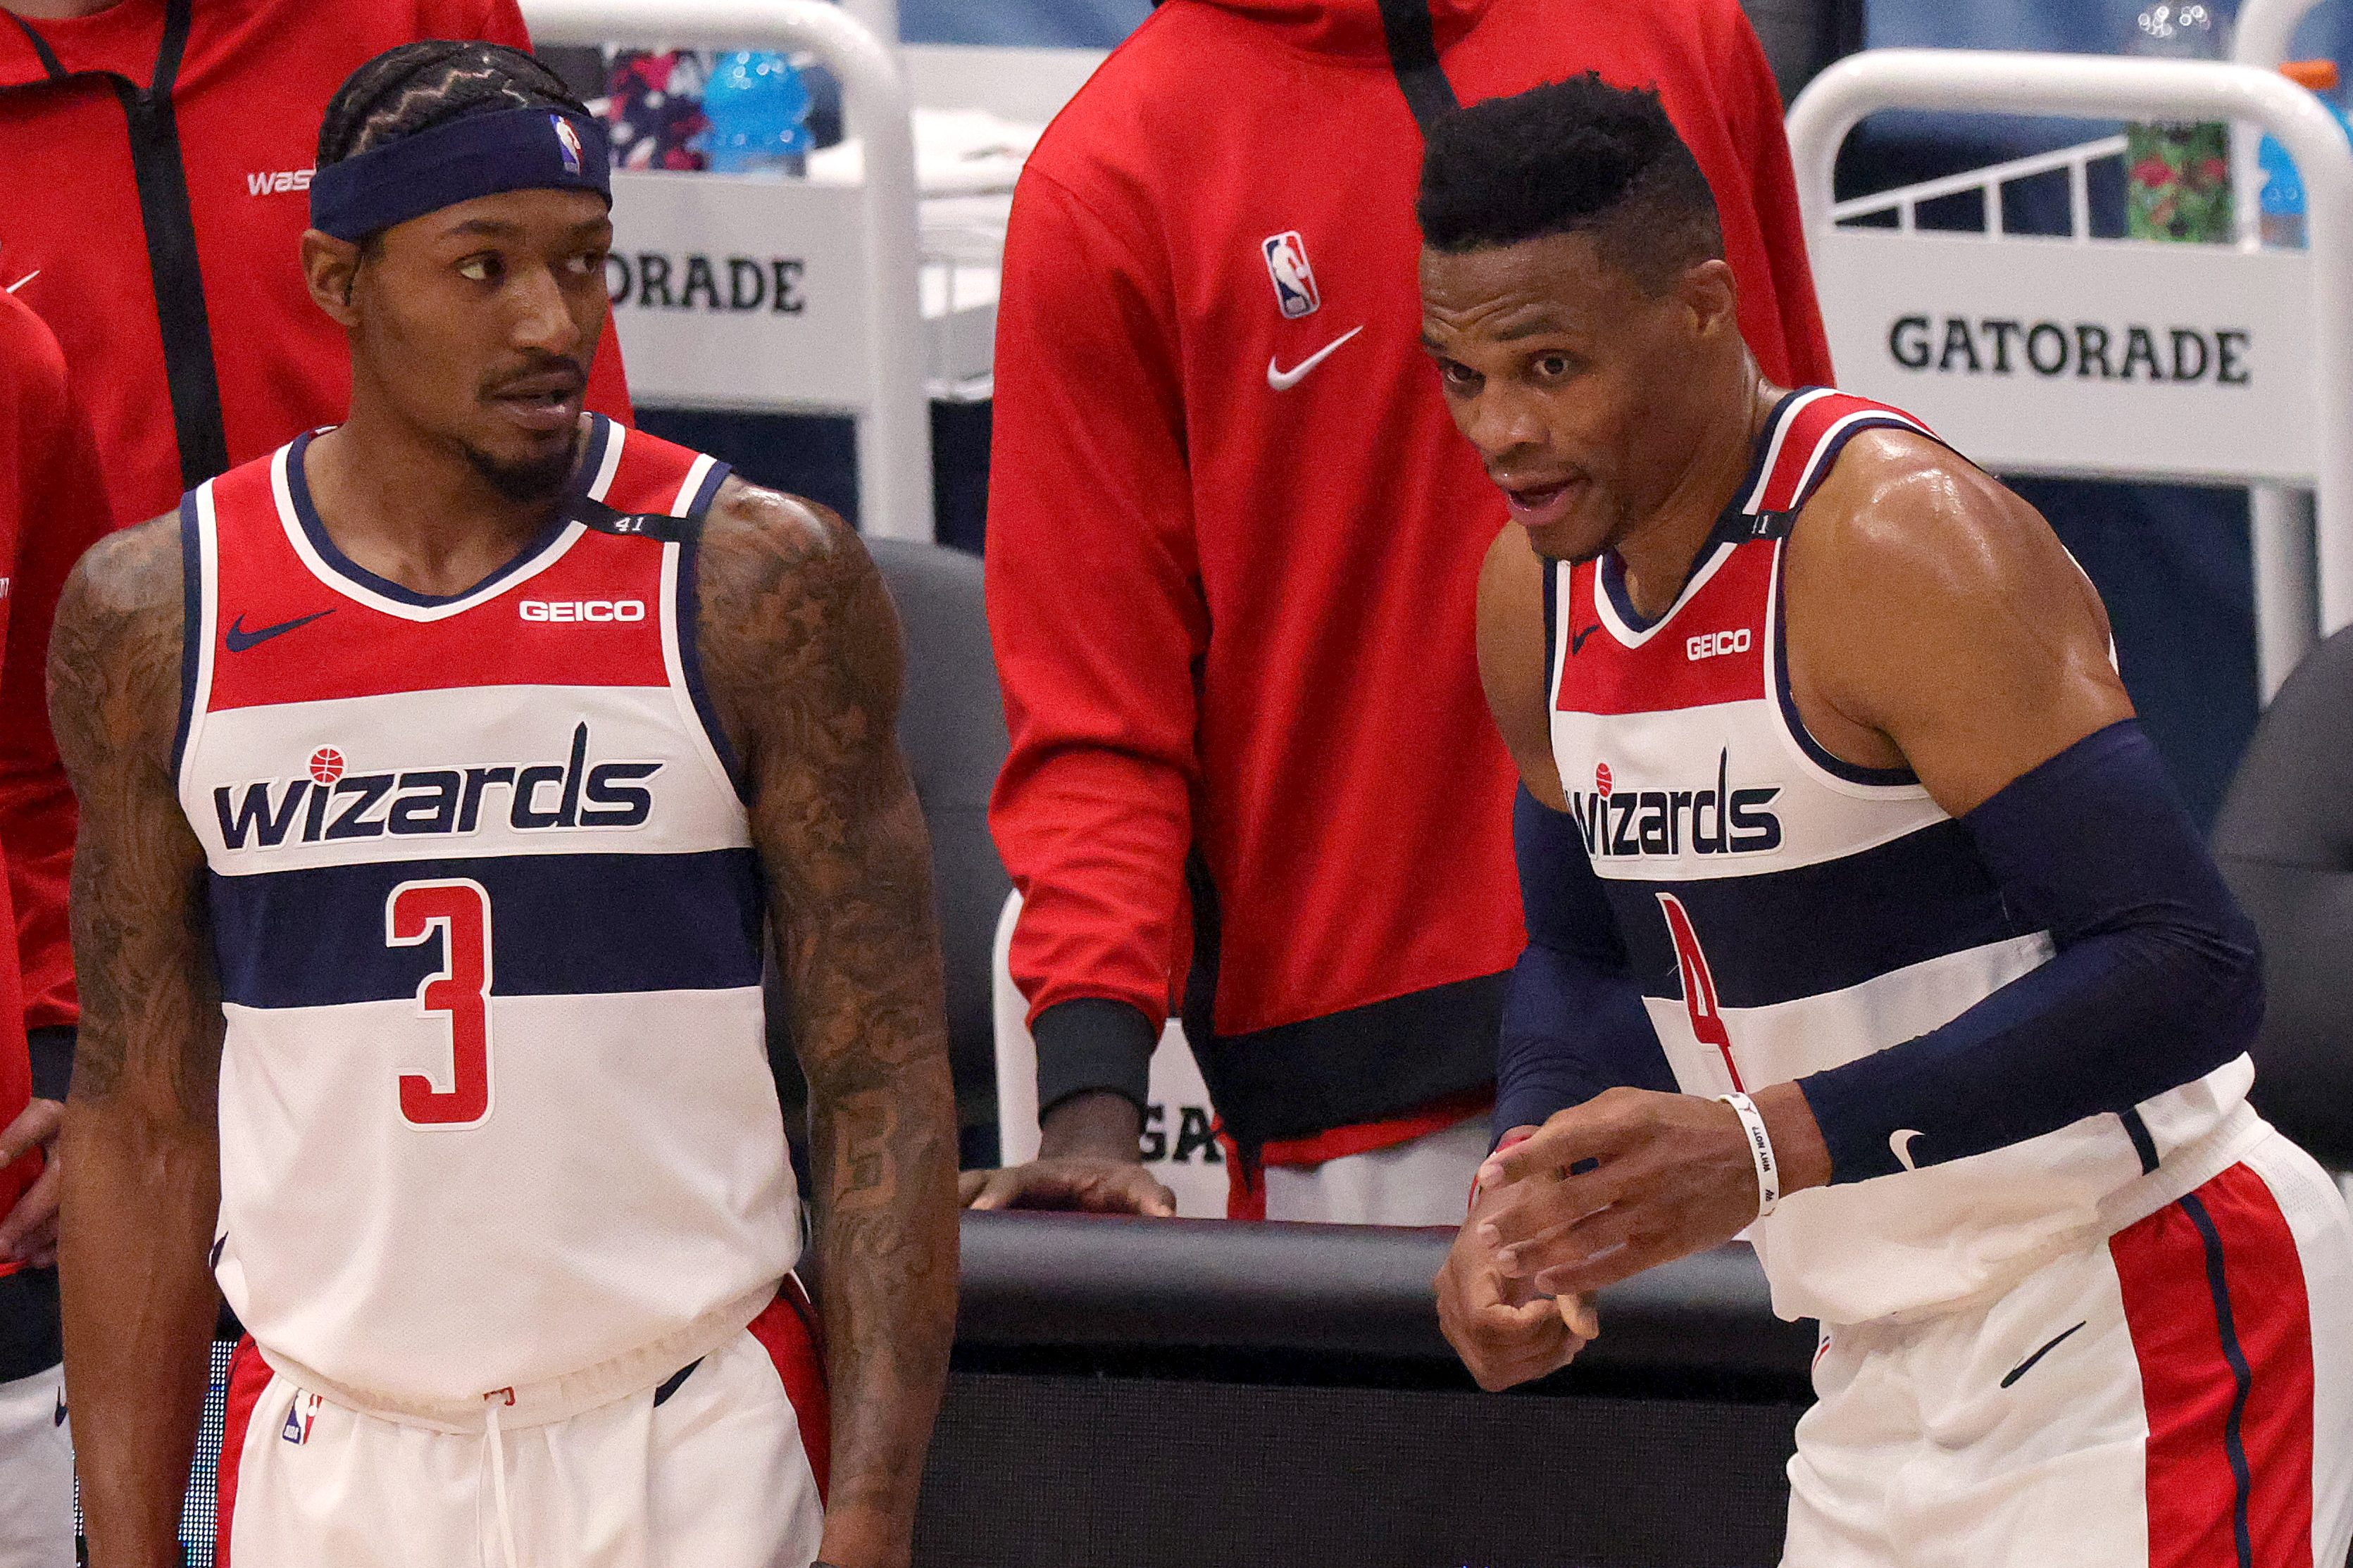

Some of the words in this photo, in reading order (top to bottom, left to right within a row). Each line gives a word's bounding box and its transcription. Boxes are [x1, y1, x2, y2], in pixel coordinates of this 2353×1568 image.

[247, 159, 316, 196] was
[1889, 314, 2251, 385] GATORADE
[615, 516, 644, 532] 41
[519, 601, 645, 622] GEICO
[1686, 628, 1752, 661] GEICO
[213, 721, 663, 849] wizards
[386, 877, 496, 1131] 3
[1752, 1126, 1766, 1149] NOT?
[1759, 1150, 1771, 1172] WHY
